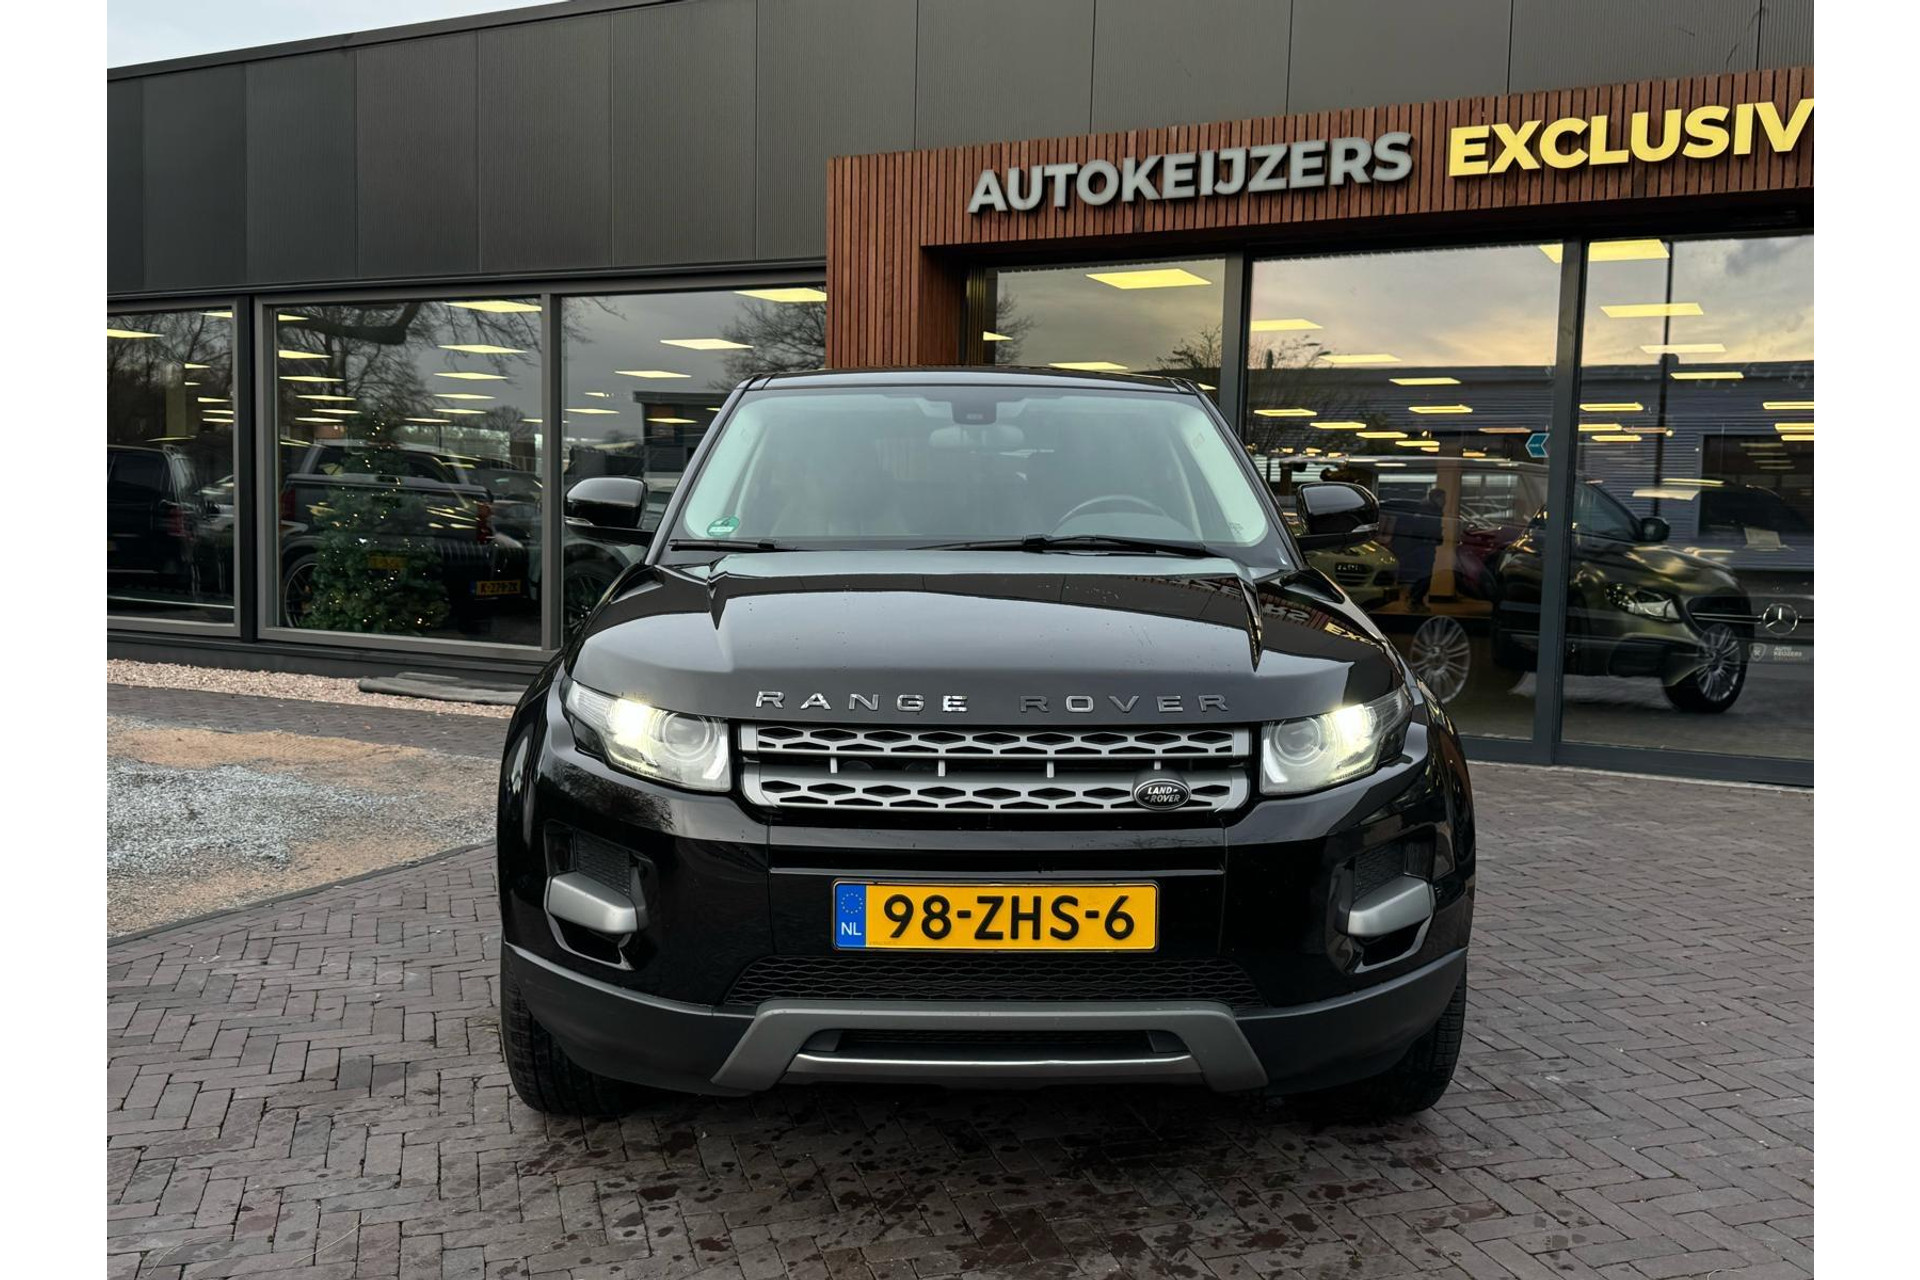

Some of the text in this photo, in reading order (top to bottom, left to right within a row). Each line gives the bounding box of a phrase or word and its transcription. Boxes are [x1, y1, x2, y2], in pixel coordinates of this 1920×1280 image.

[968, 97, 1814, 214] AUTOKEIJZERS EXCLUSIV
[755, 691, 1230, 713] RANGE ROVER
[1147, 786, 1173, 795] LAND
[1150, 795, 1181, 803] ROVER
[884, 894, 1135, 940] 98-ZHS-6
[841, 922, 862, 935] NL
